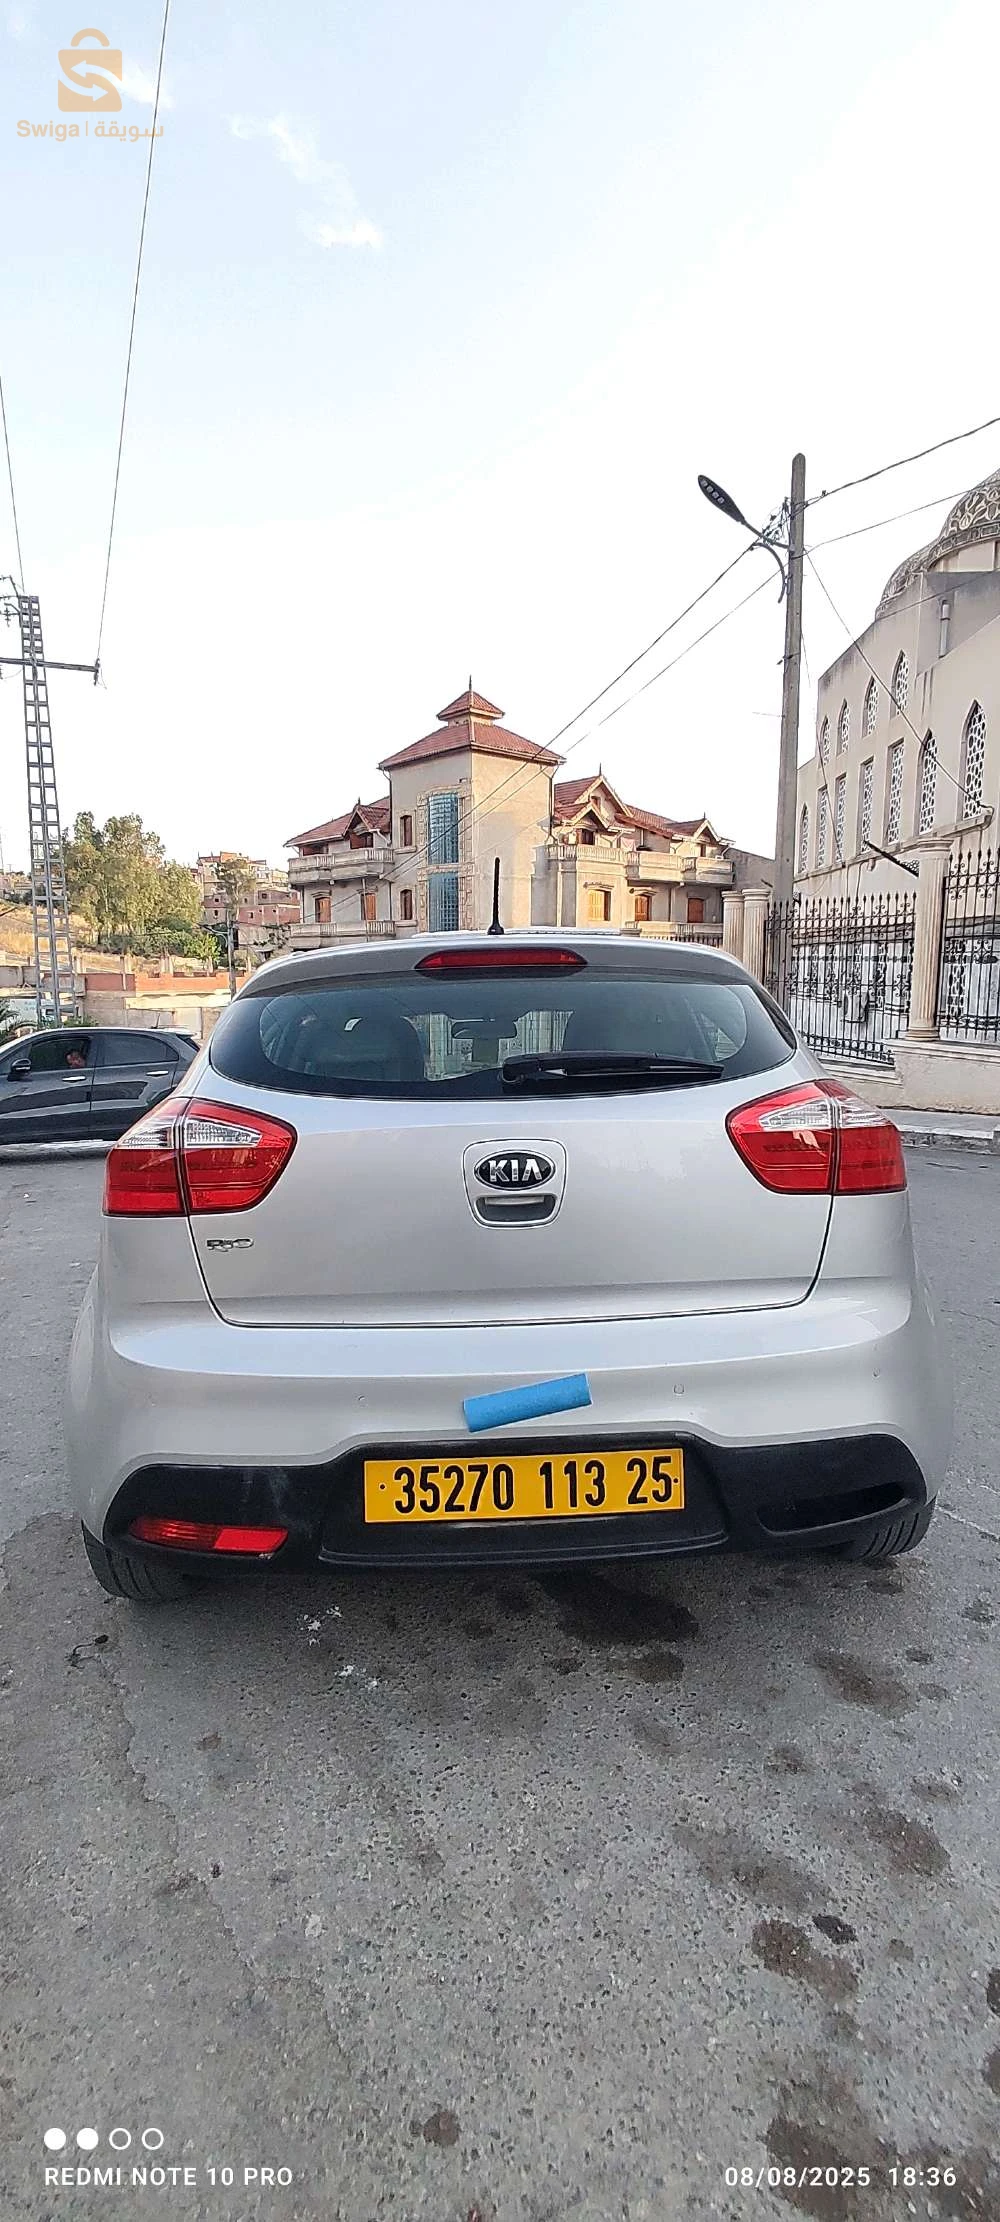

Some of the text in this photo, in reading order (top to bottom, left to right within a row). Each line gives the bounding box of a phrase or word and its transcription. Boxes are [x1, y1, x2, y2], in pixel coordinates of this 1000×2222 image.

[488, 1159, 542, 1182] KIA
[393, 1455, 672, 1514] 35270 113 25
